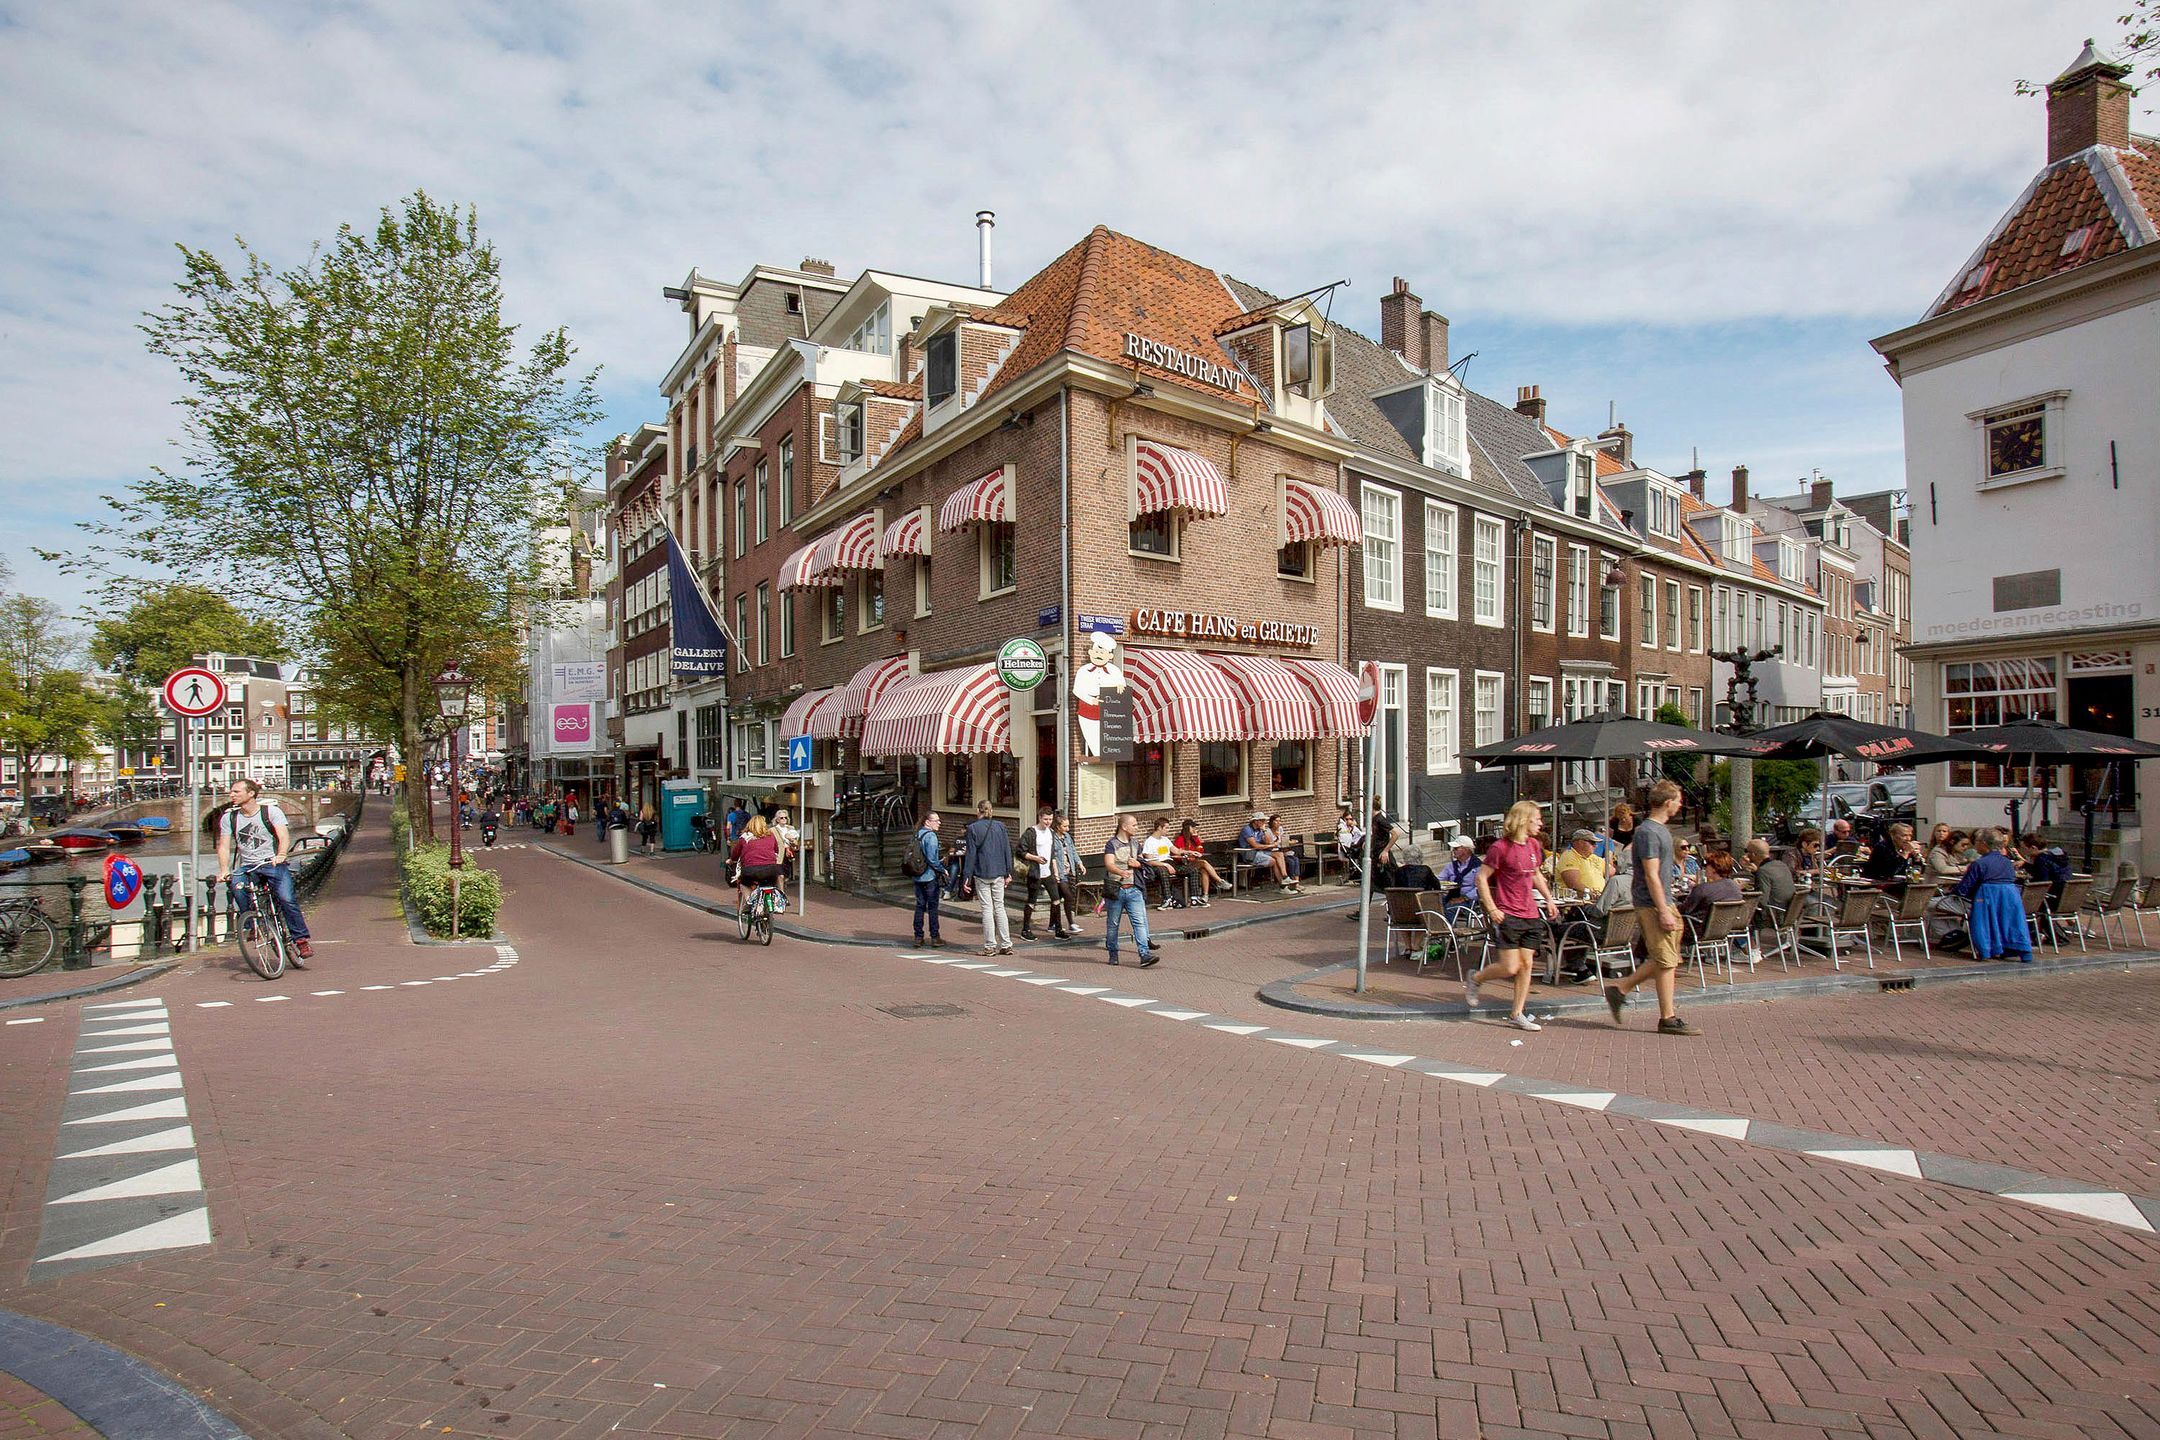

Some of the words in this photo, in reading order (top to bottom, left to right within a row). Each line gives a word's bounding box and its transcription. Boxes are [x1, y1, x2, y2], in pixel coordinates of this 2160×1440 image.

[1126, 332, 1244, 393] RESTAURANT
[1927, 602, 2142, 636] moederannecasting
[1137, 608, 1185, 633] CAFE
[1191, 613, 1237, 638] HANS
[1241, 625, 1257, 640] en
[1259, 621, 1320, 645] GRIETJE
[674, 647, 726, 658] GALLERY
[672, 661, 725, 671] DELAIVE
[1004, 659, 1043, 669] Heineken
[568, 667, 595, 676] E.M.G.
[1643, 739, 1699, 748] PALM
[1855, 737, 1914, 757] PALM
